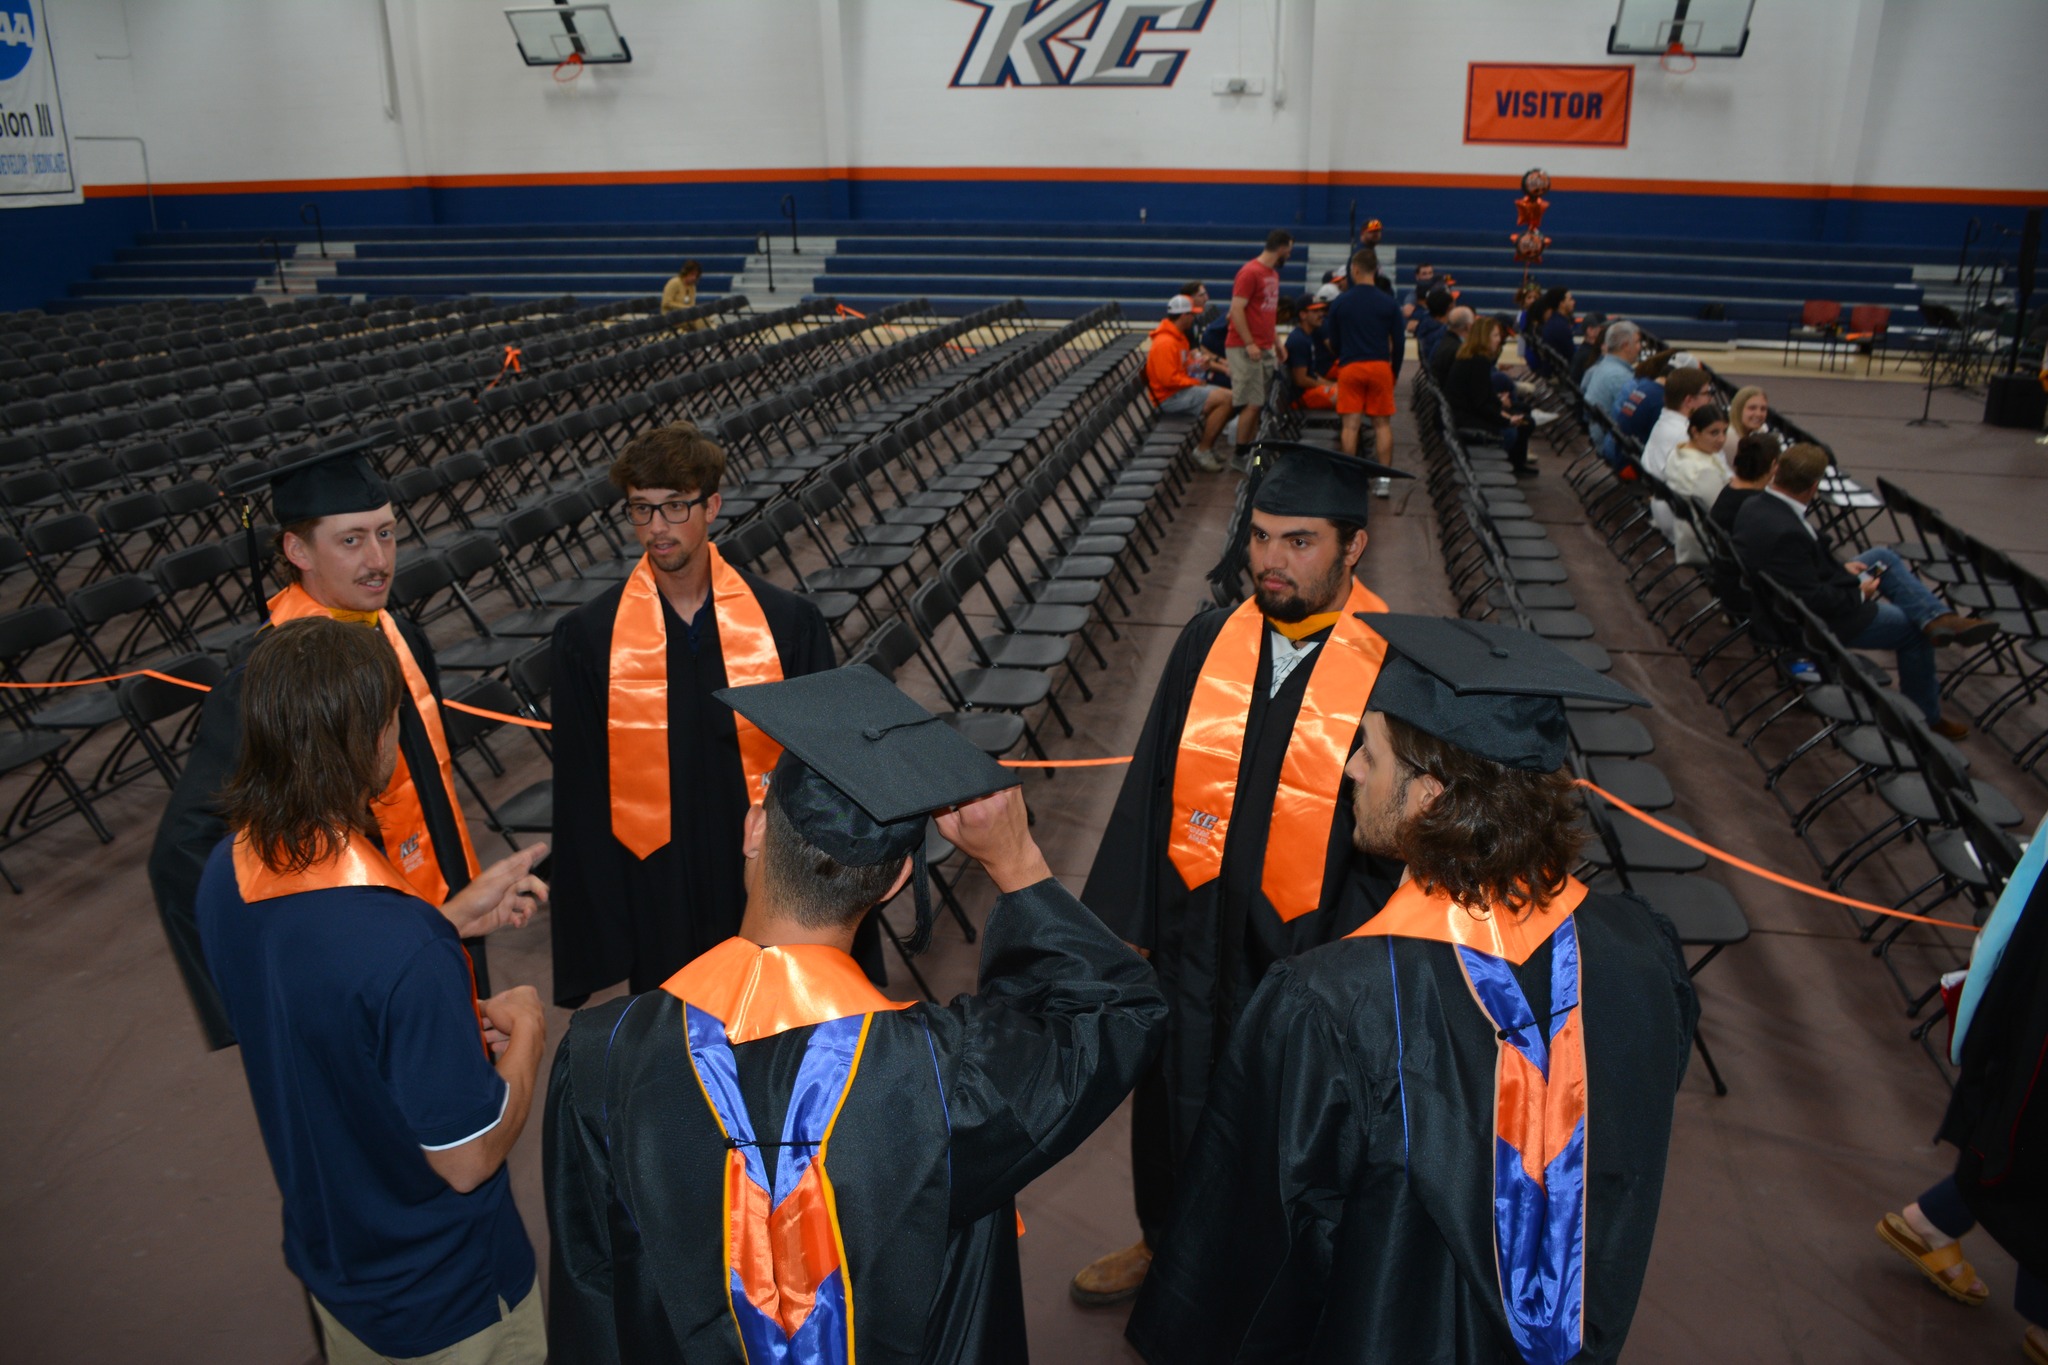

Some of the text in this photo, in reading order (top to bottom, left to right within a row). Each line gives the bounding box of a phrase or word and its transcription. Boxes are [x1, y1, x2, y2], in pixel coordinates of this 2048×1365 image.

[1496, 90, 1604, 119] VISITOR
[0, 103, 34, 137] ion
[1190, 809, 1220, 831] KC
